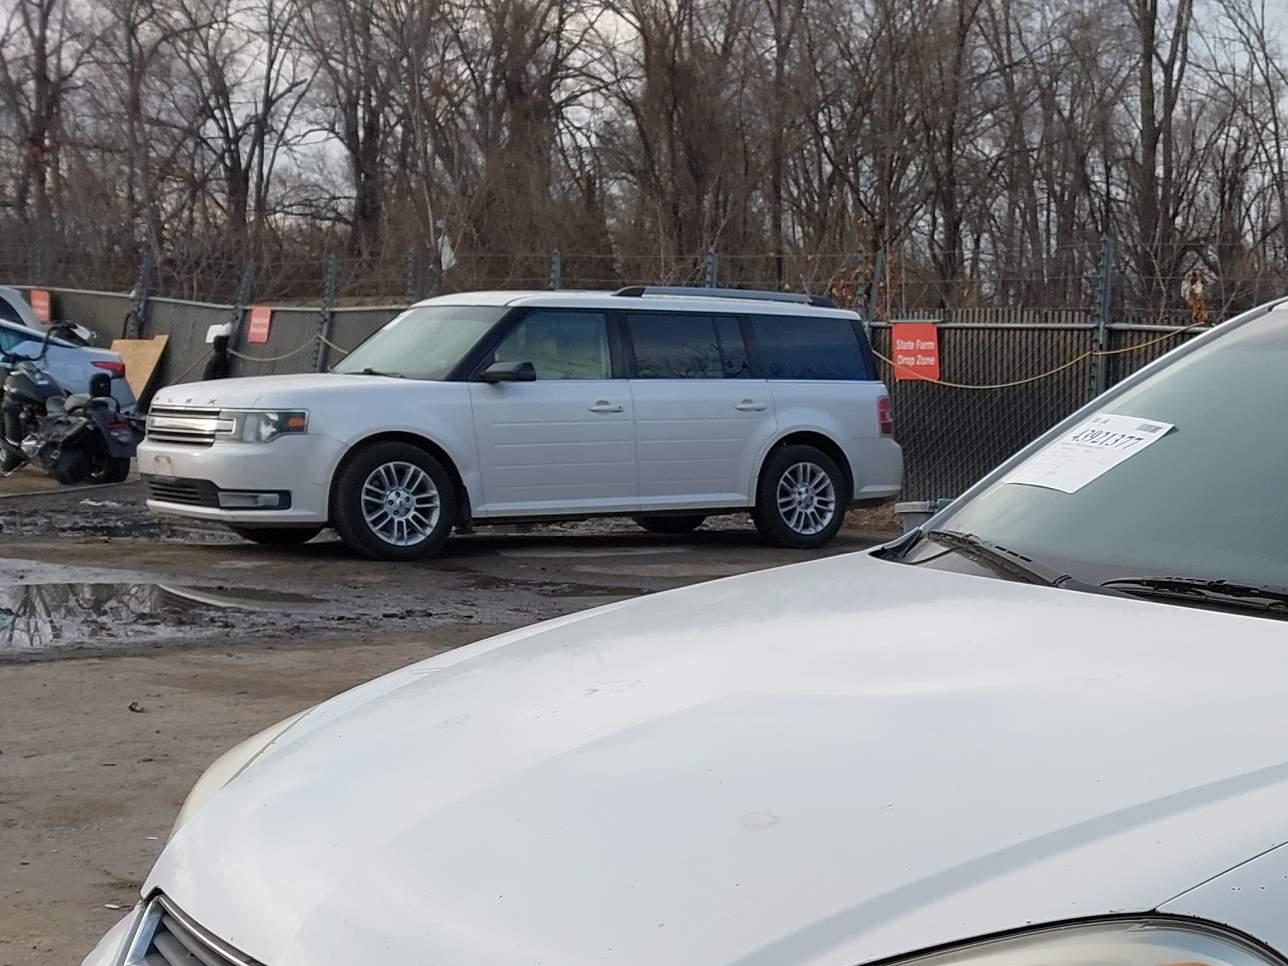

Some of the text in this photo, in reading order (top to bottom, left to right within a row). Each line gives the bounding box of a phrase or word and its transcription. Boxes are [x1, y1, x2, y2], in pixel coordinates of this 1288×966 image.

[896, 340, 935, 350] State Farm
[897, 355, 935, 367] Drop Zone
